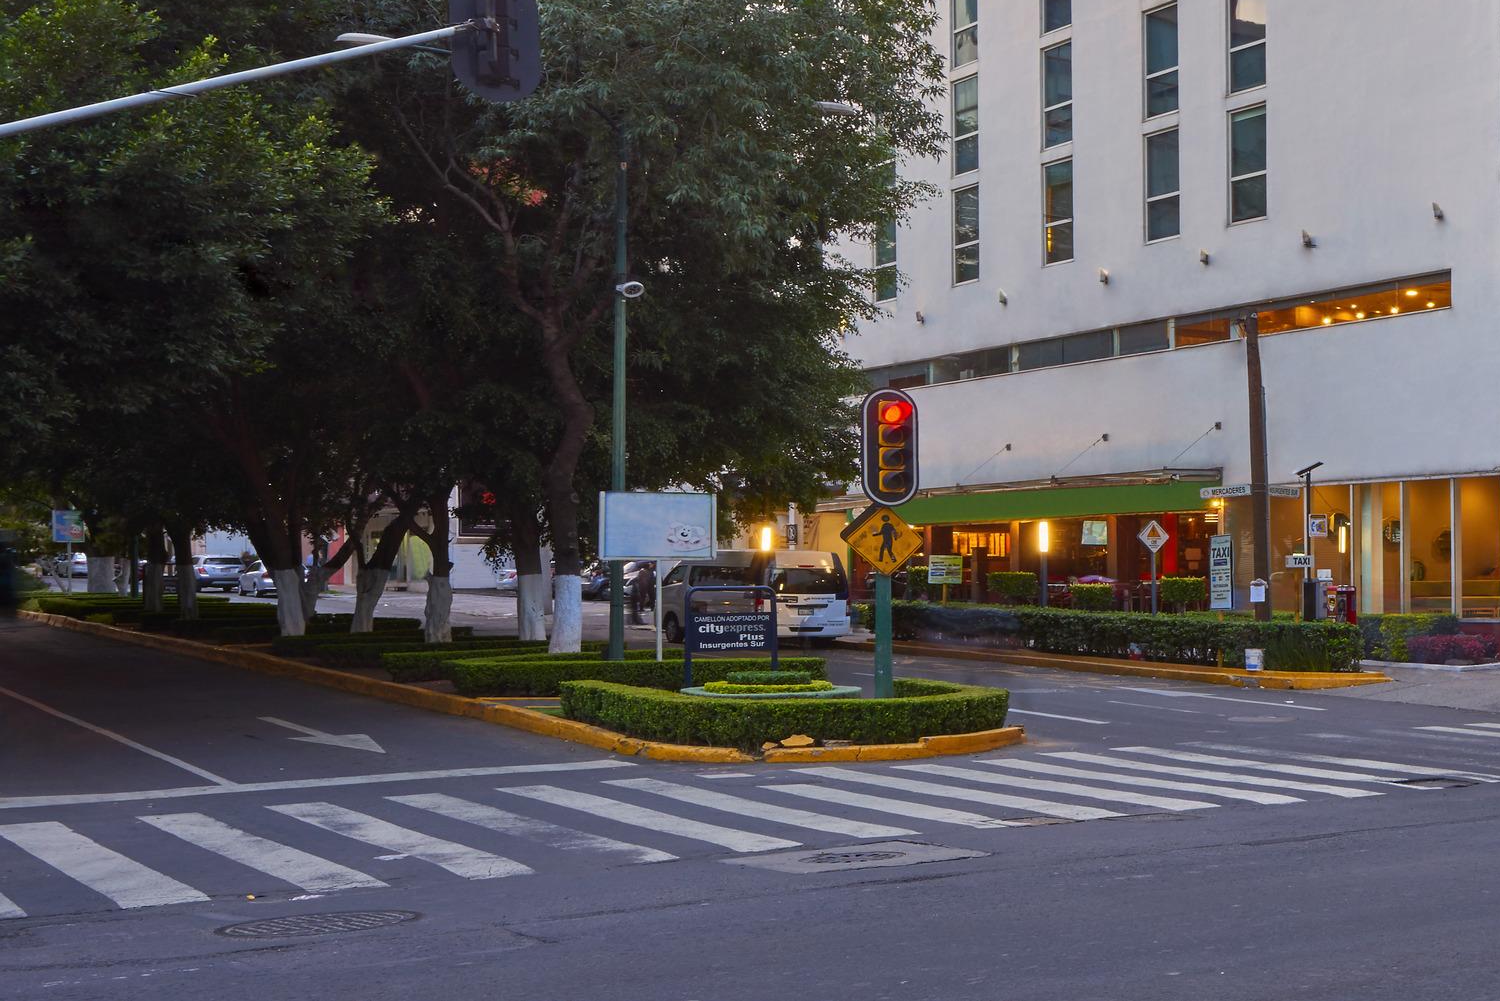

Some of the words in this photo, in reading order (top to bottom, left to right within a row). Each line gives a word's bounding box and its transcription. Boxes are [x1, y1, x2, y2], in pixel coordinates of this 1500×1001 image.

[1211, 486, 1246, 496] MERCADERES
[1211, 546, 1230, 558] TAXI
[1293, 557, 1310, 565] TAXI
[740, 633, 765, 641] Plus
[699, 641, 748, 649] Insurgentes
